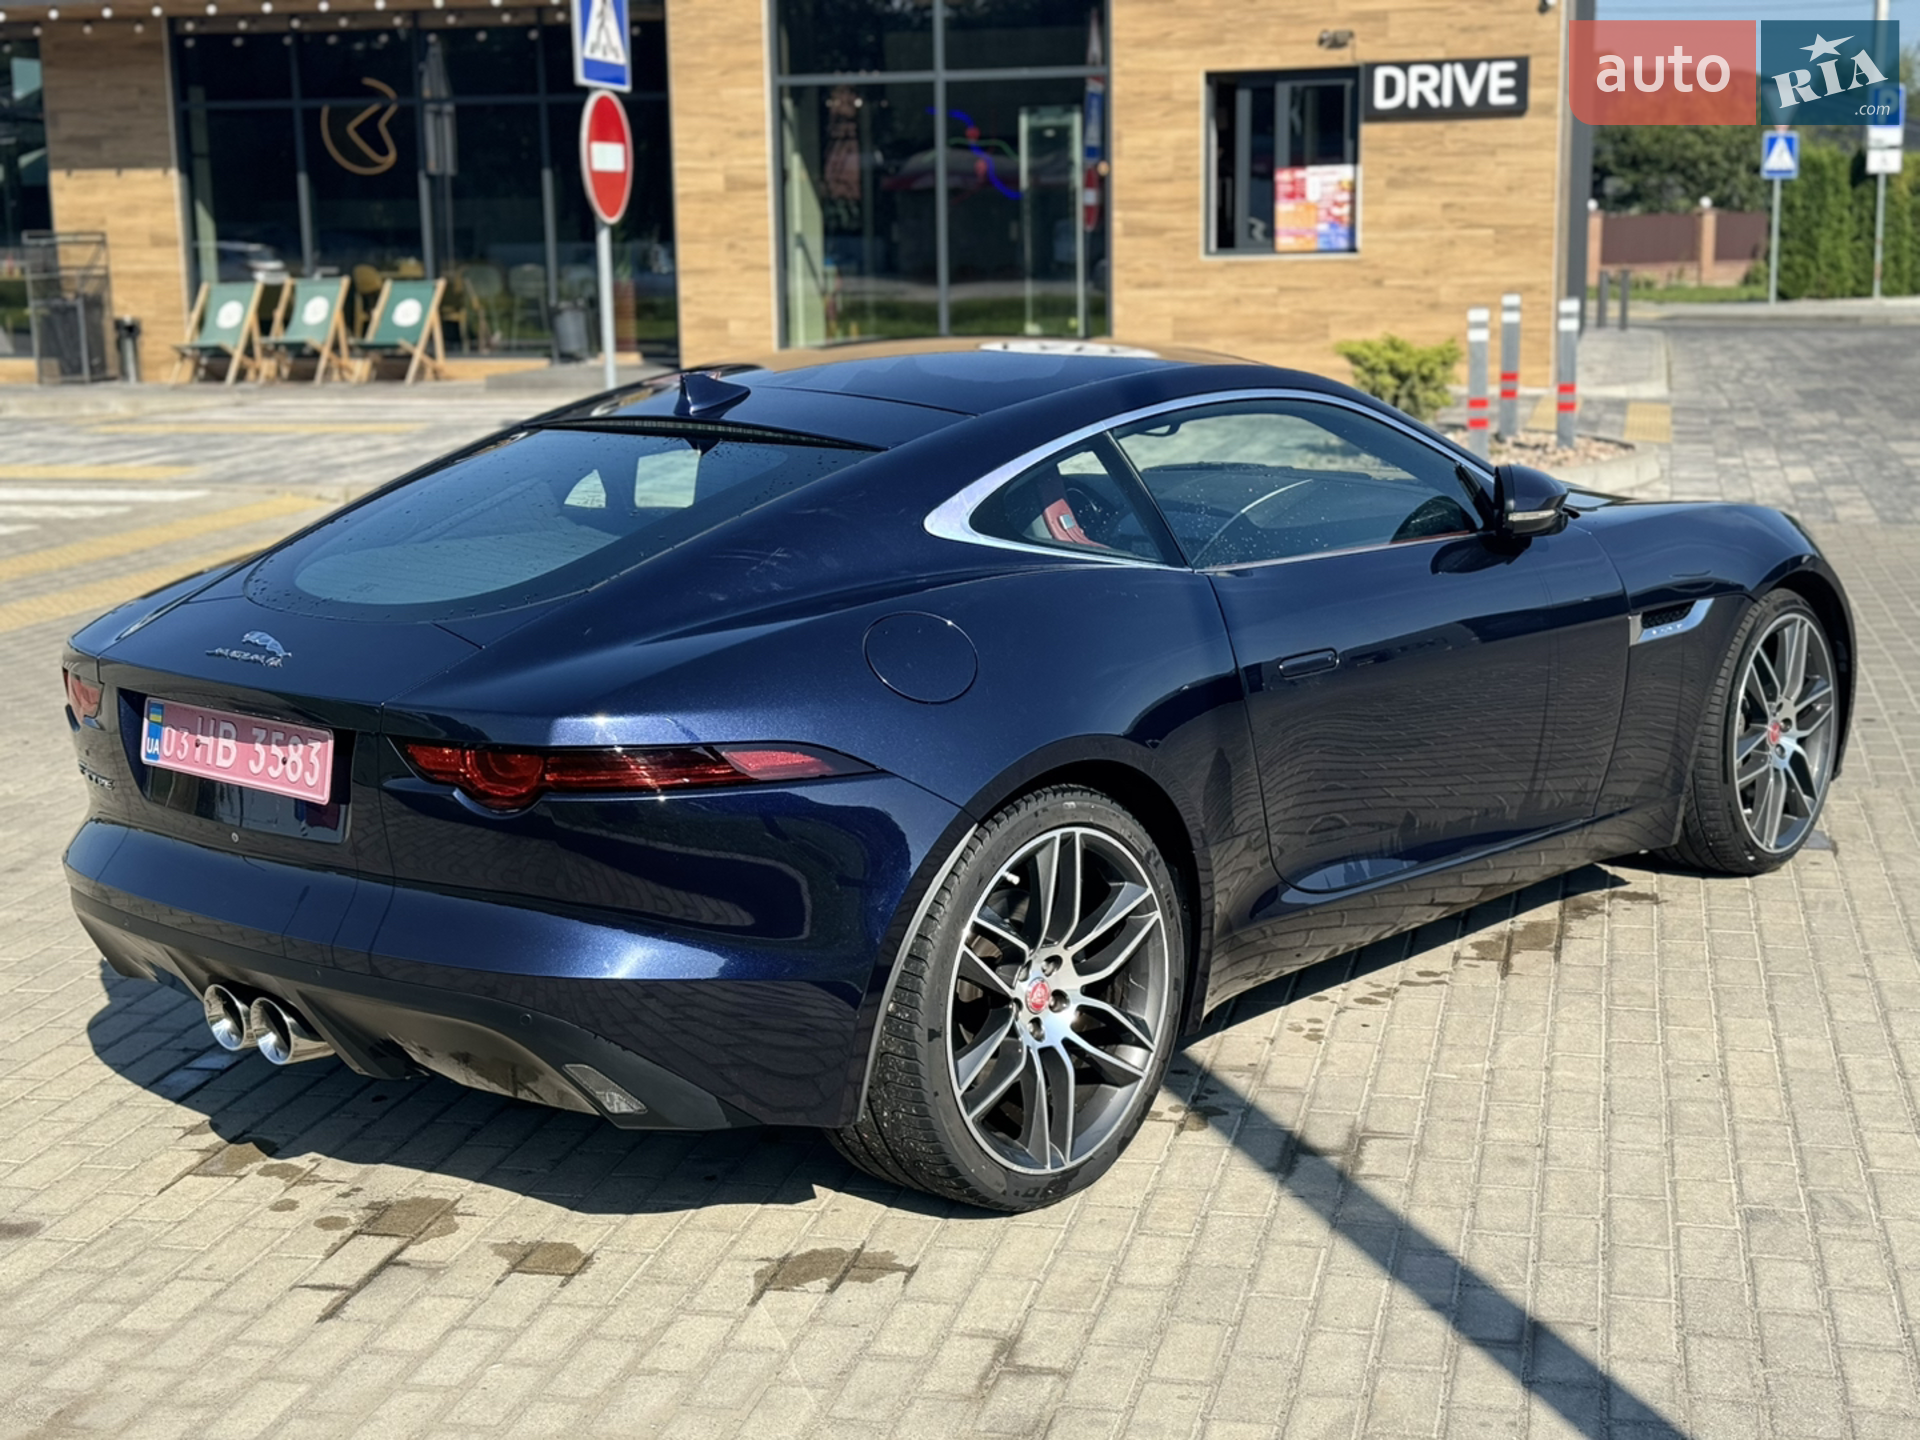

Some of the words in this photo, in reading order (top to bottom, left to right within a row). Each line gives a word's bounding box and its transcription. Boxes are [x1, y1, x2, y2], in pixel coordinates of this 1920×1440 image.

[1374, 60, 1517, 110] DRIVE
[146, 737, 160, 754] UA
[163, 726, 190, 760] 03
[194, 716, 238, 768] HB
[249, 727, 321, 786] 3583
